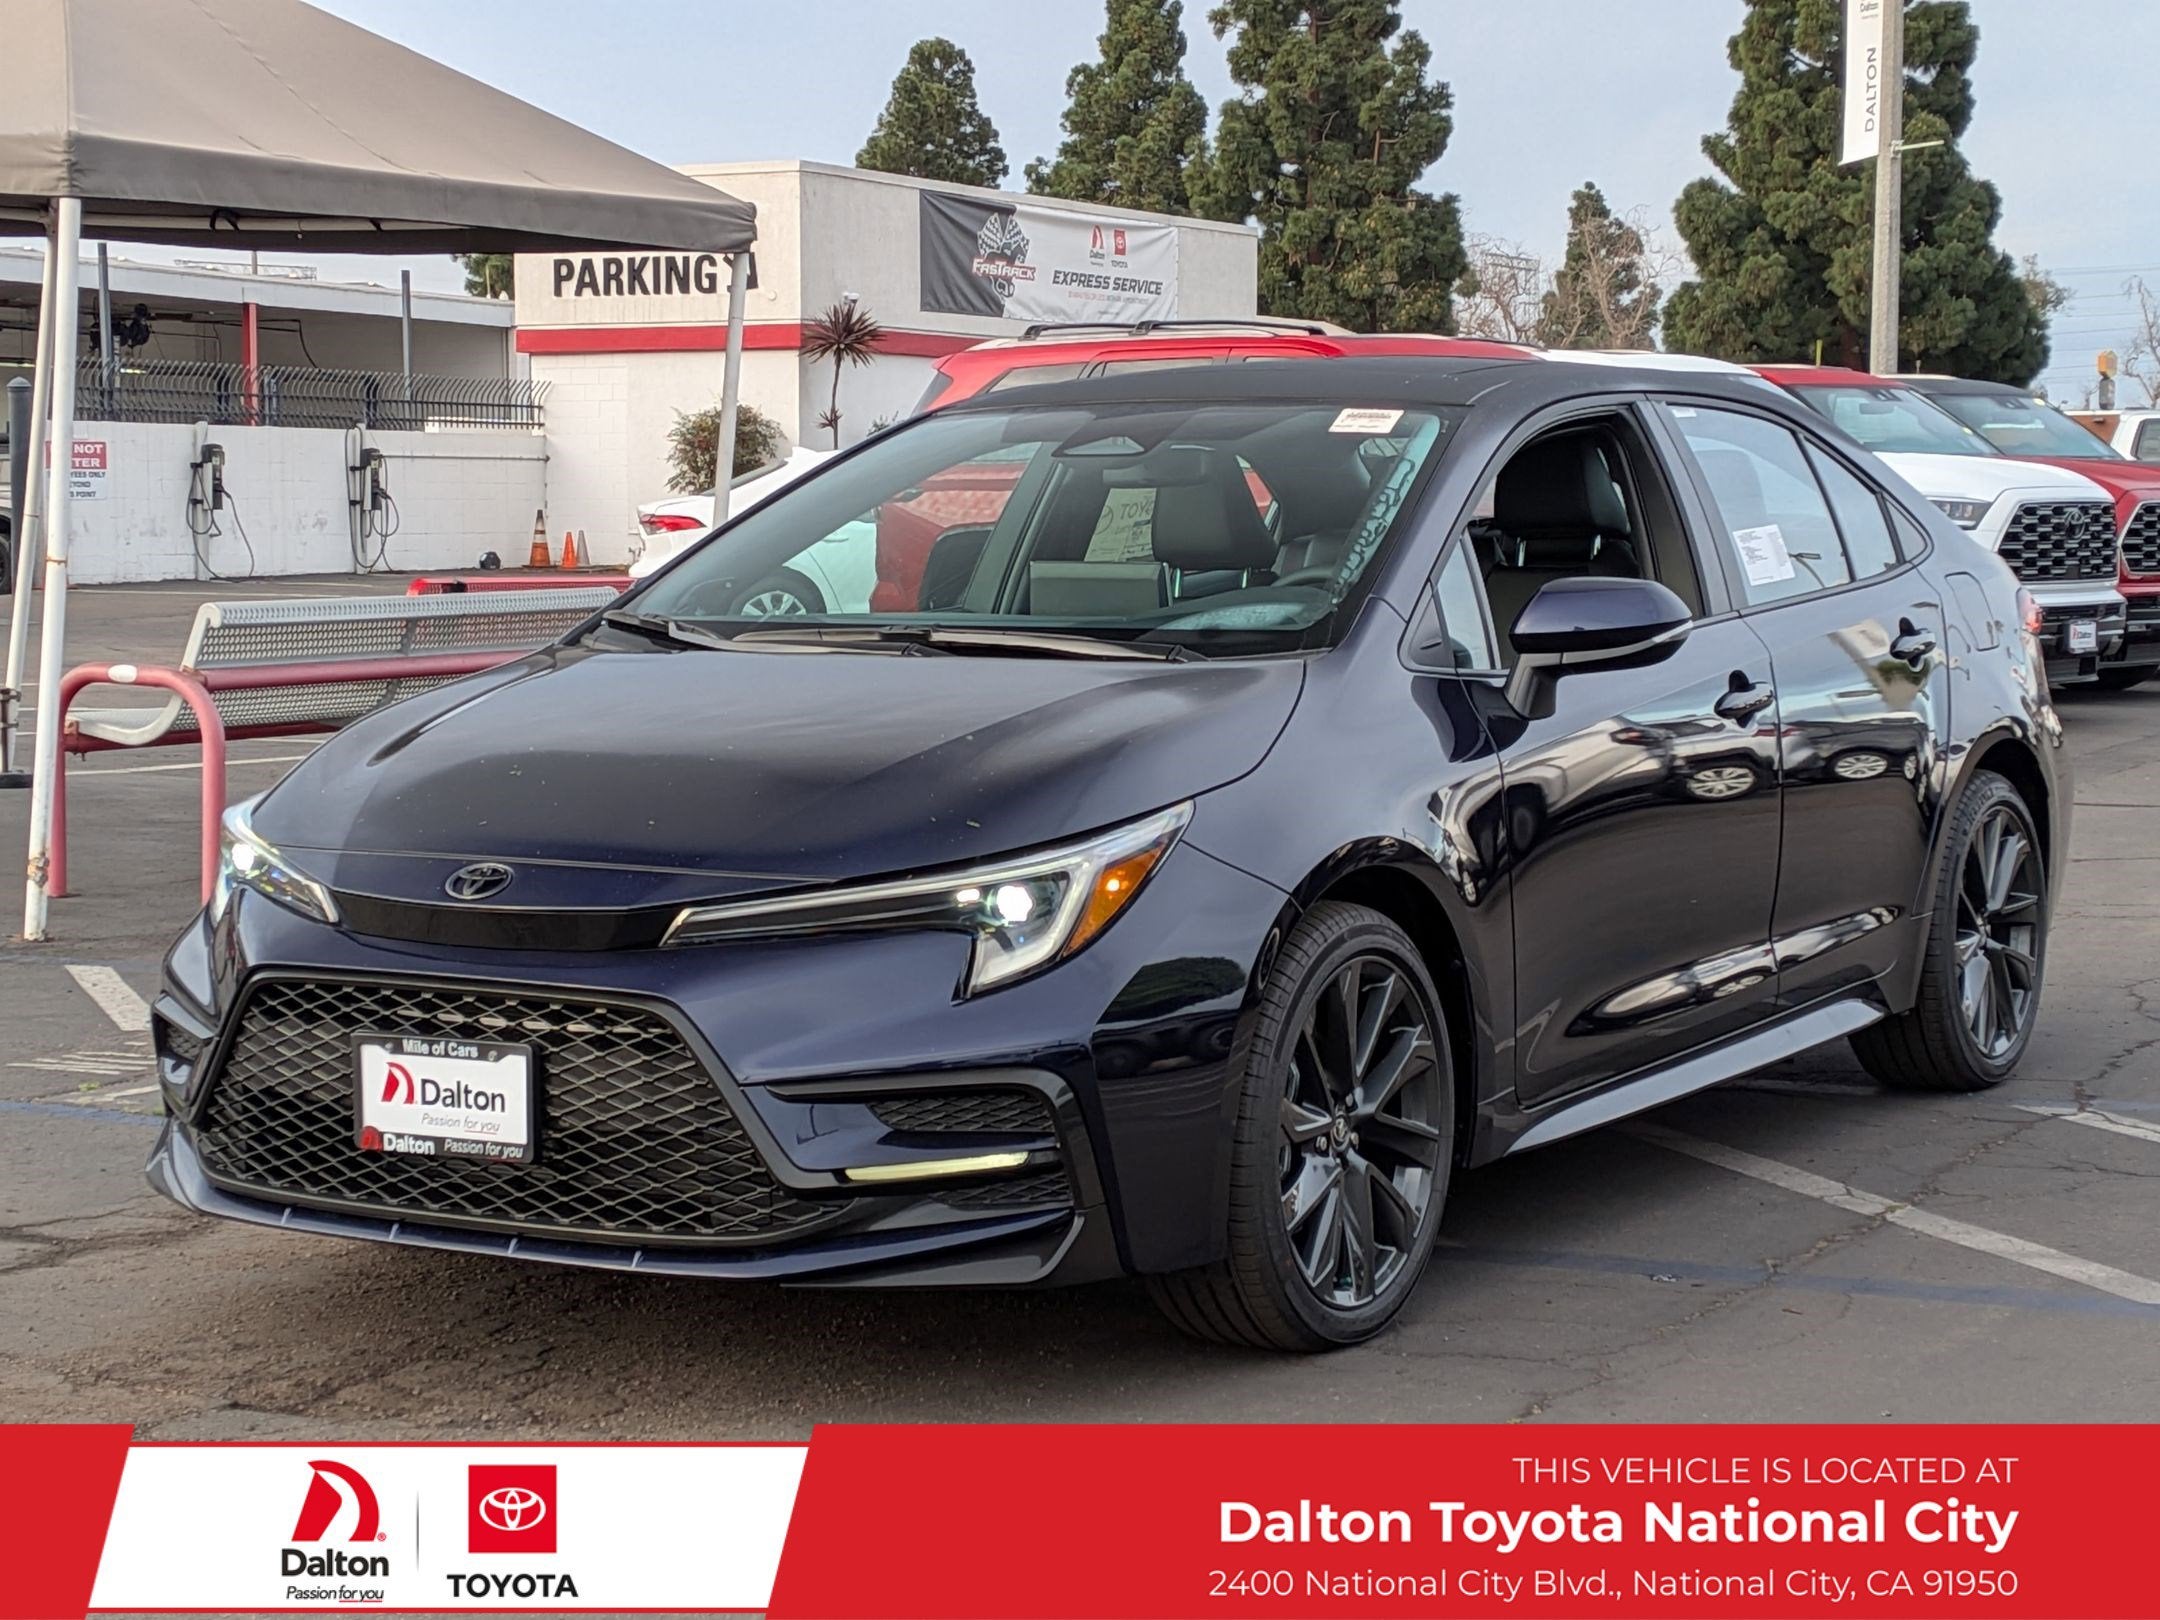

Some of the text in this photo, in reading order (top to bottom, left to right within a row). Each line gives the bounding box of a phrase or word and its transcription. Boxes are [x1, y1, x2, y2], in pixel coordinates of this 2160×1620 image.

[1864, 47, 1878, 133] DALTON
[553, 254, 718, 297] PARKING
[1052, 269, 1163, 296] EXPRESS SERVICE
[74, 444, 103, 454] NOT
[71, 457, 101, 468] TER
[402, 1038, 479, 1058] Mile of Cars
[421, 1078, 506, 1113] Dalton
[421, 1112, 501, 1133] Passion for you
[383, 1133, 435, 1155] Dalton
[444, 1138, 523, 1160] Passion for you
